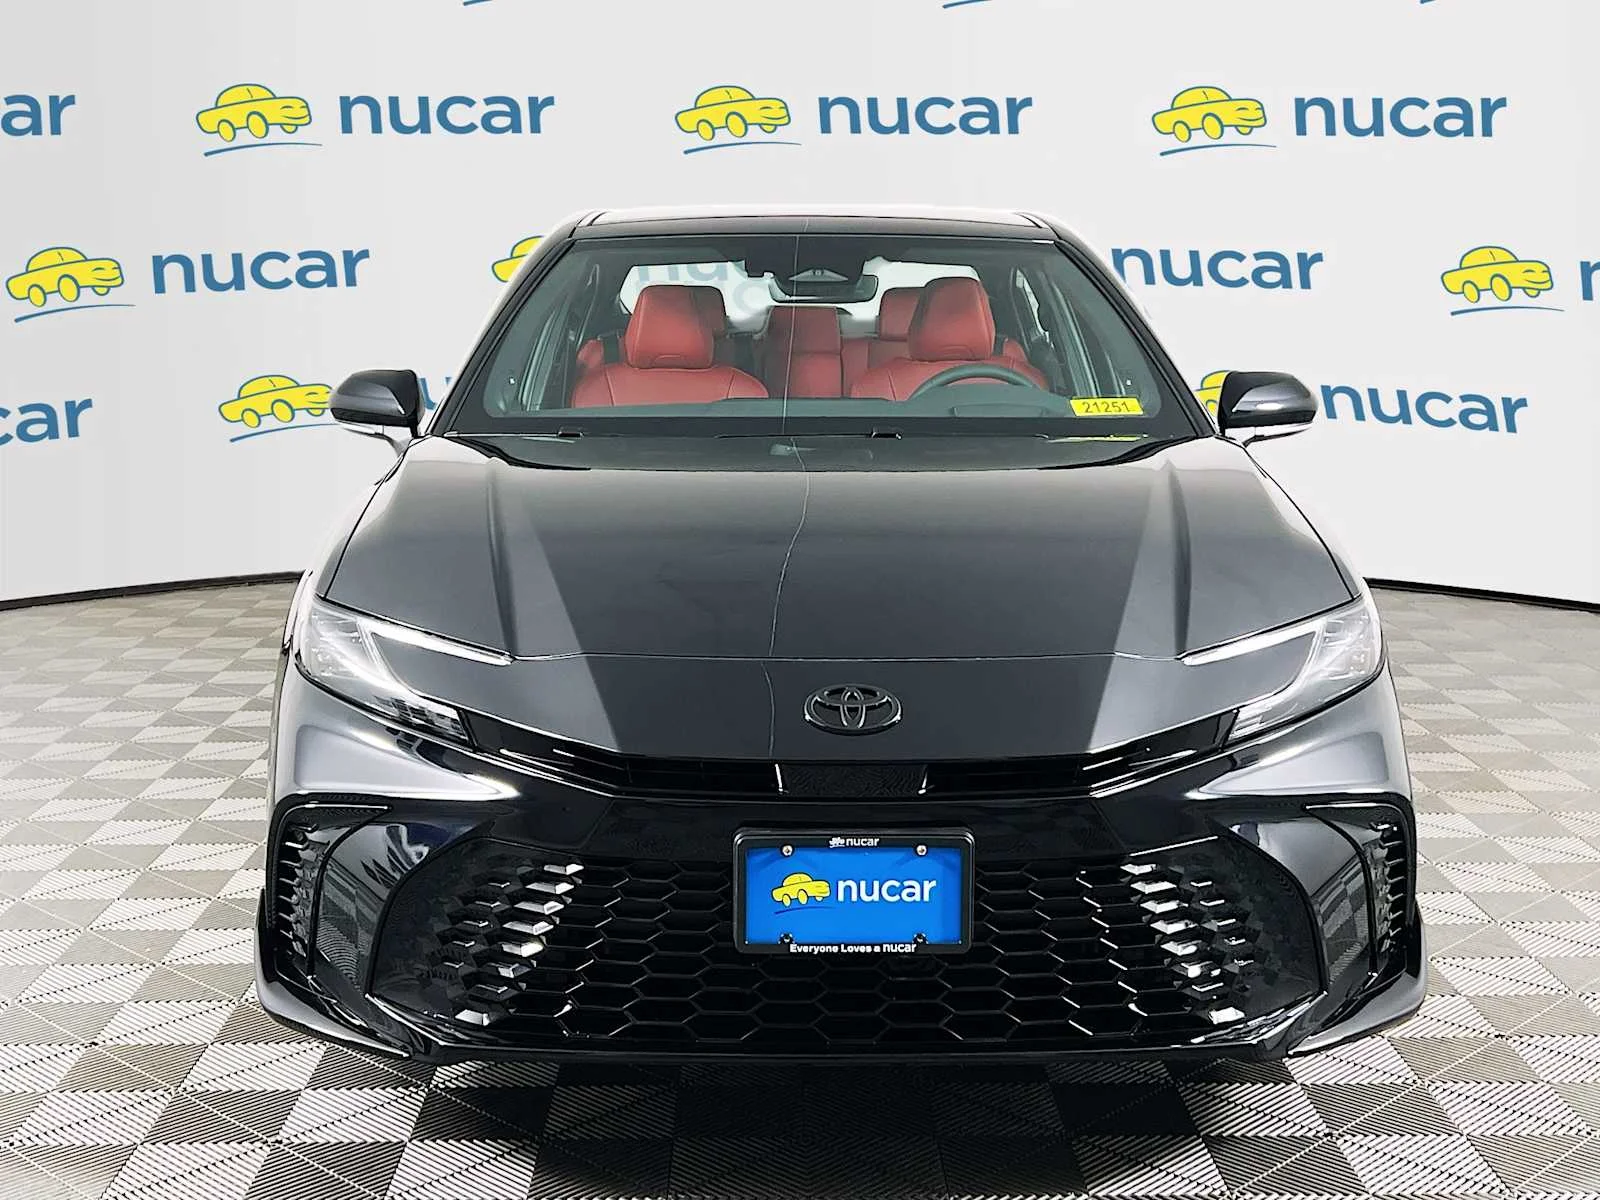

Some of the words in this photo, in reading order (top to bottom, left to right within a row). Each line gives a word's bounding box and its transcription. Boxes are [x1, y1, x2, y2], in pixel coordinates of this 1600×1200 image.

[339, 94, 555, 135] nucar
[818, 95, 1033, 135] nucar
[1293, 96, 1507, 137] nucar
[151, 248, 369, 294] nucar
[1110, 247, 1323, 289] nucar
[1082, 401, 1130, 413] 21251
[1320, 384, 1528, 433] nucar
[845, 837, 880, 847] nucar
[836, 878, 937, 902] nucar
[789, 943, 839, 955] Everyone
[840, 943, 872, 953] Loves
[873, 945, 881, 953] a
[882, 943, 917, 953] nucar
